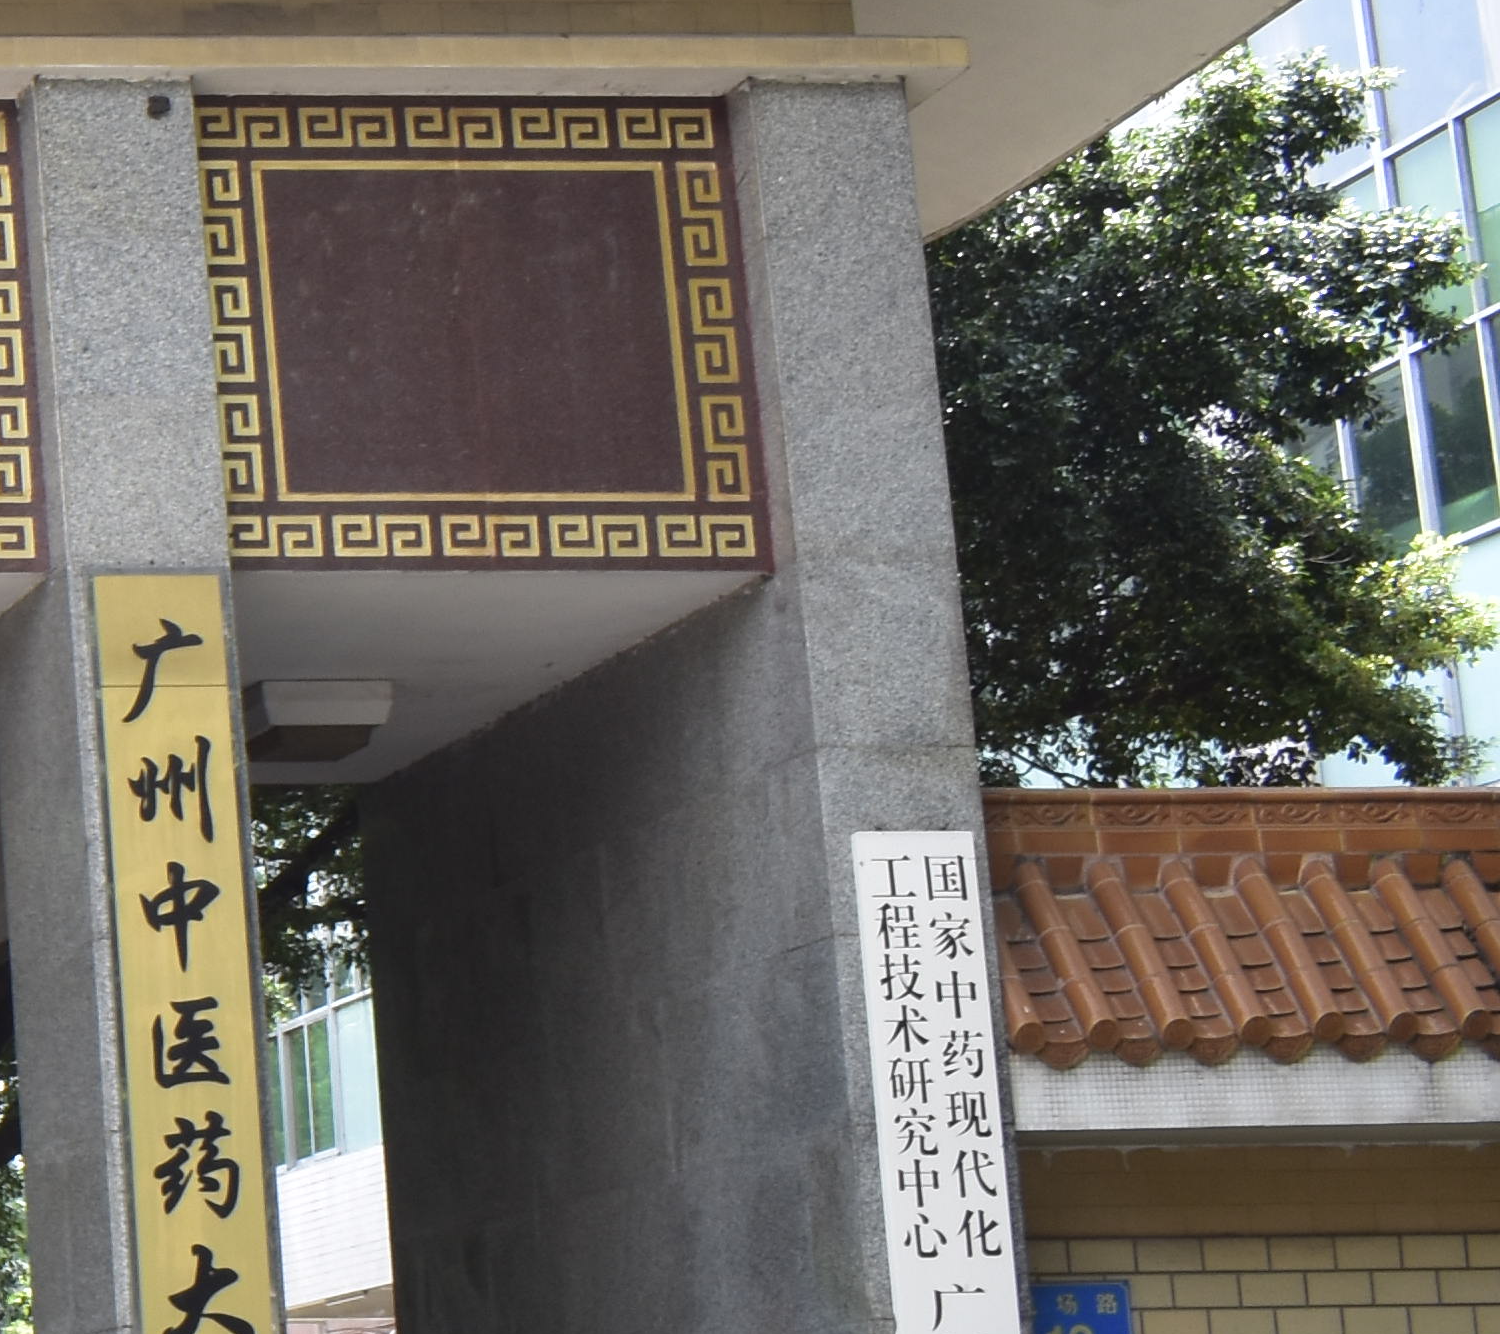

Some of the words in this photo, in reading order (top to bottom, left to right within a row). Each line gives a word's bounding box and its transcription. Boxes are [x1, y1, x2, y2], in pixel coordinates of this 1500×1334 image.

[870, 853, 947, 1259] 工程技术研究中心
[925, 853, 1003, 1259] 国家中药现代化
[1033, 1293, 1117, 1315] 场路
